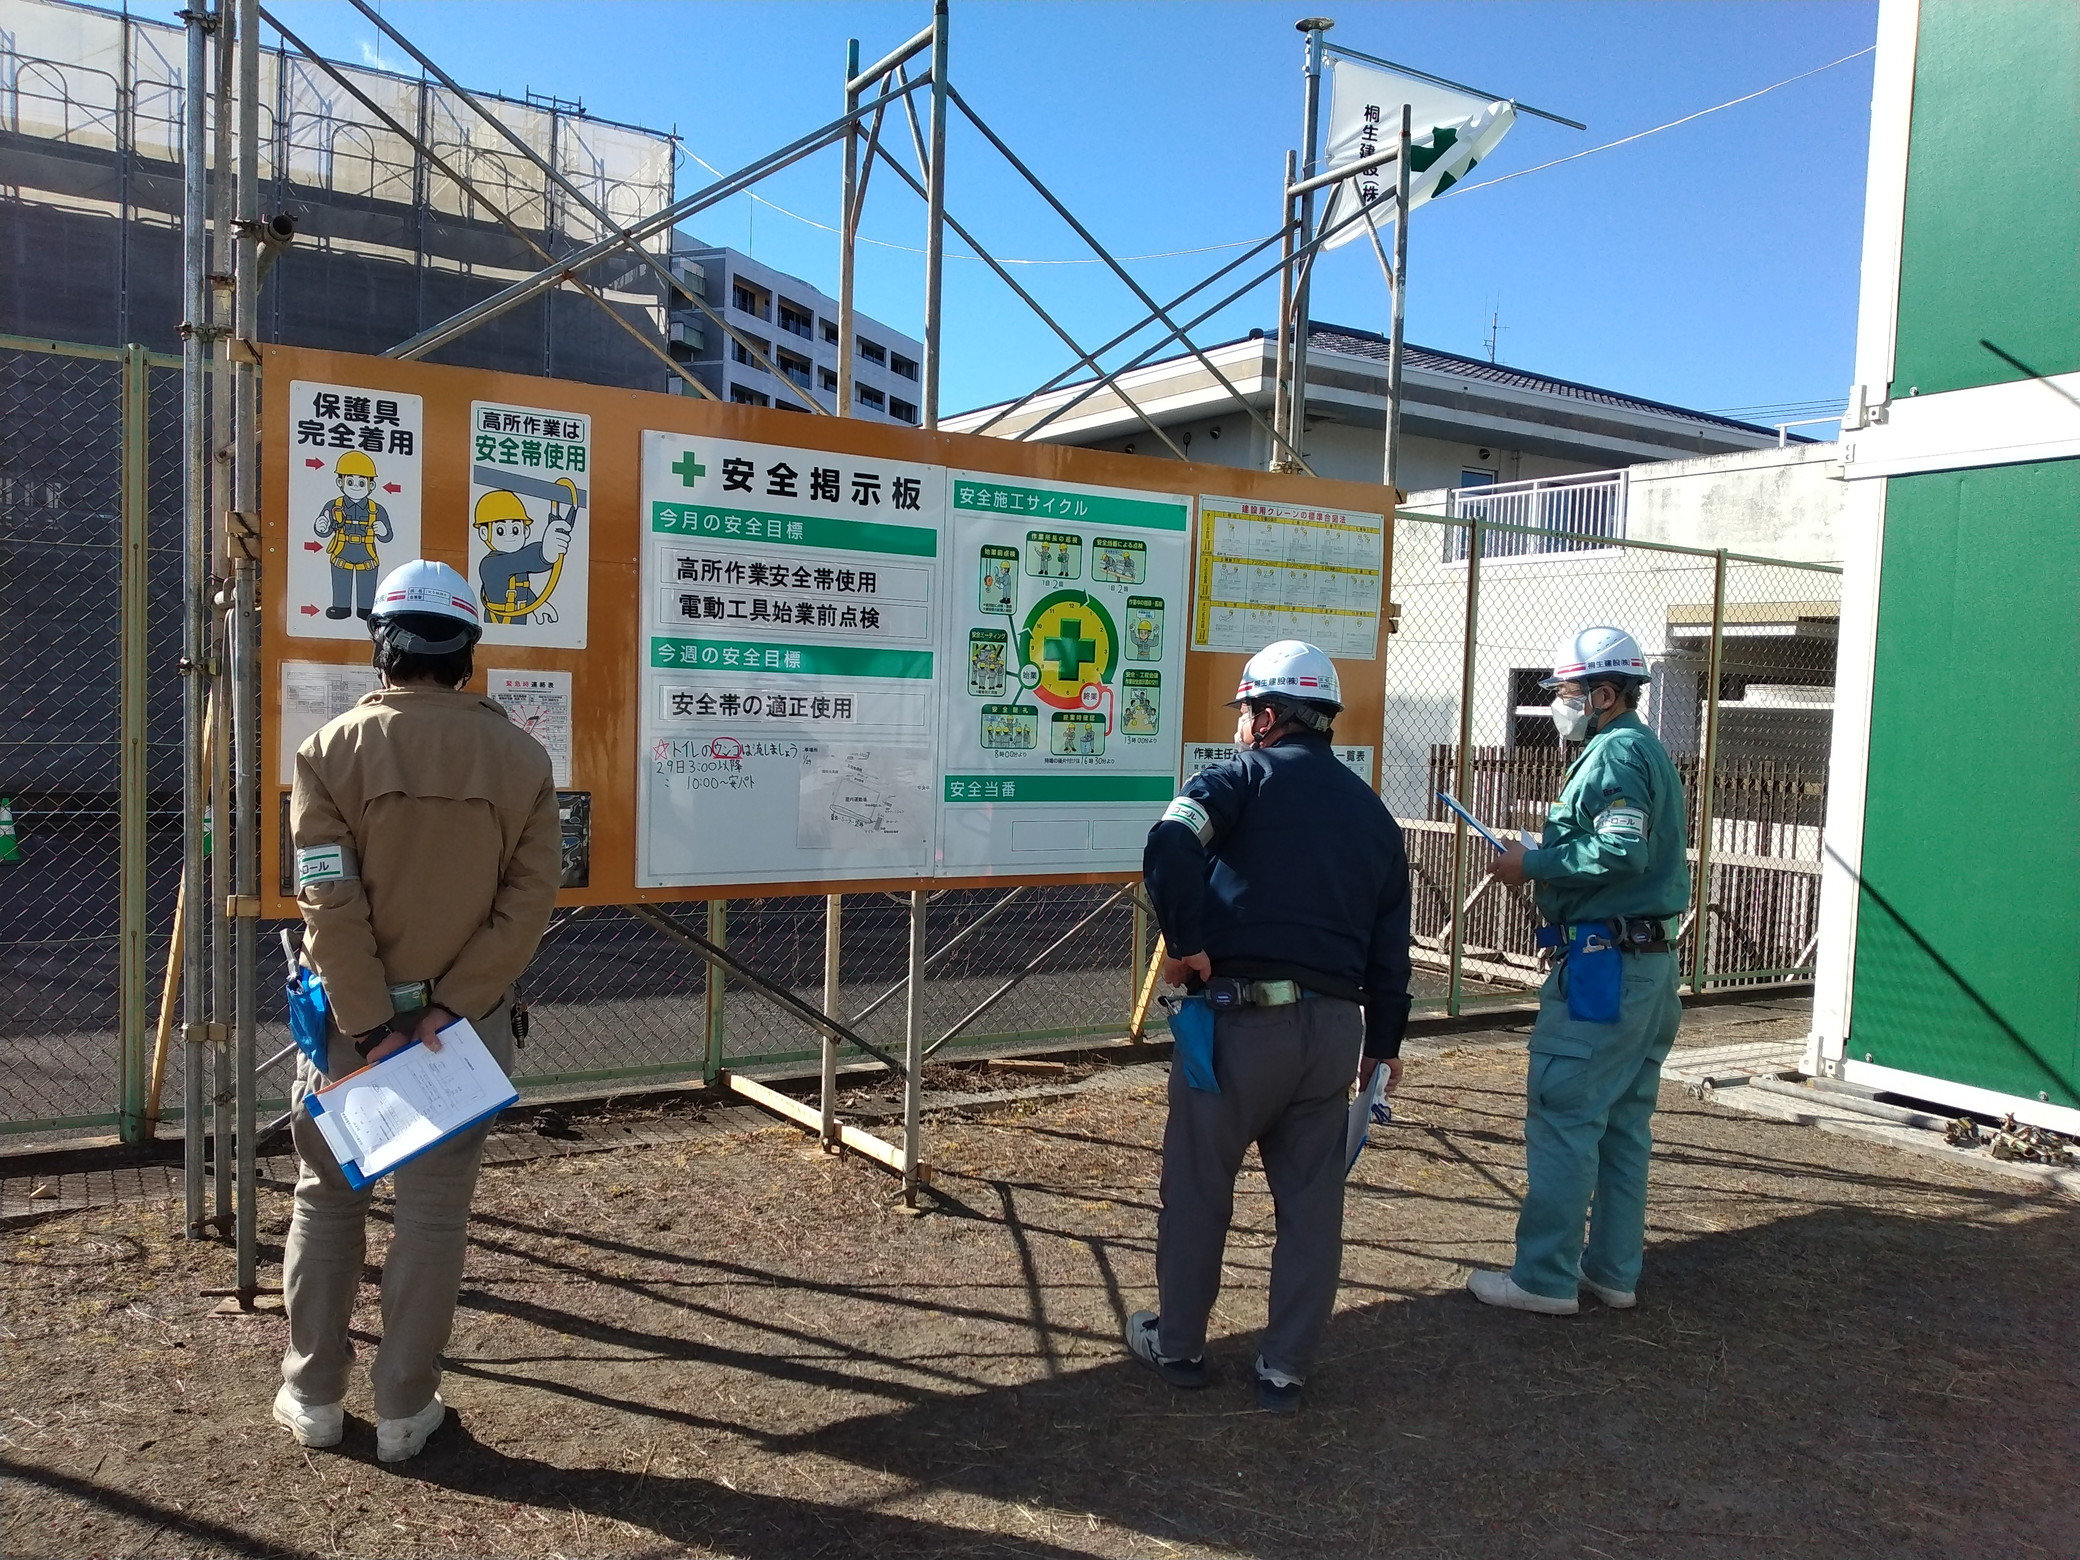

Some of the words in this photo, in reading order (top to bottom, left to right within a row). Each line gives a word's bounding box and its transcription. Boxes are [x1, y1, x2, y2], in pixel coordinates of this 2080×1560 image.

[313, 391, 400, 427] 保護具
[297, 419, 414, 457] 完全着用
[482, 411, 581, 440] 高所作業は
[475, 434, 587, 473] 安全帯使用
[721, 457, 922, 512] 安全掲示板
[959, 486, 1089, 517] 安全施工サイクル
[1241, 504, 1347, 524] 建設用クレーンの標準合図法
[659, 508, 804, 541] 今月の安全目標
[676, 556, 877, 594] 高所作業安全帯使用
[678, 593, 881, 629] 電動工具始業前点検
[657, 643, 802, 669] 今週の安全目標
[1022, 671, 1038, 680] 始業
[671, 692, 852, 719] 安全帯の適正使用
[1083, 692, 1098, 701] 終業
[1193, 747, 1239, 760] 作業主任
[1336, 750, 1366, 762] 一覧表
[950, 780, 1016, 798] 安全当番
